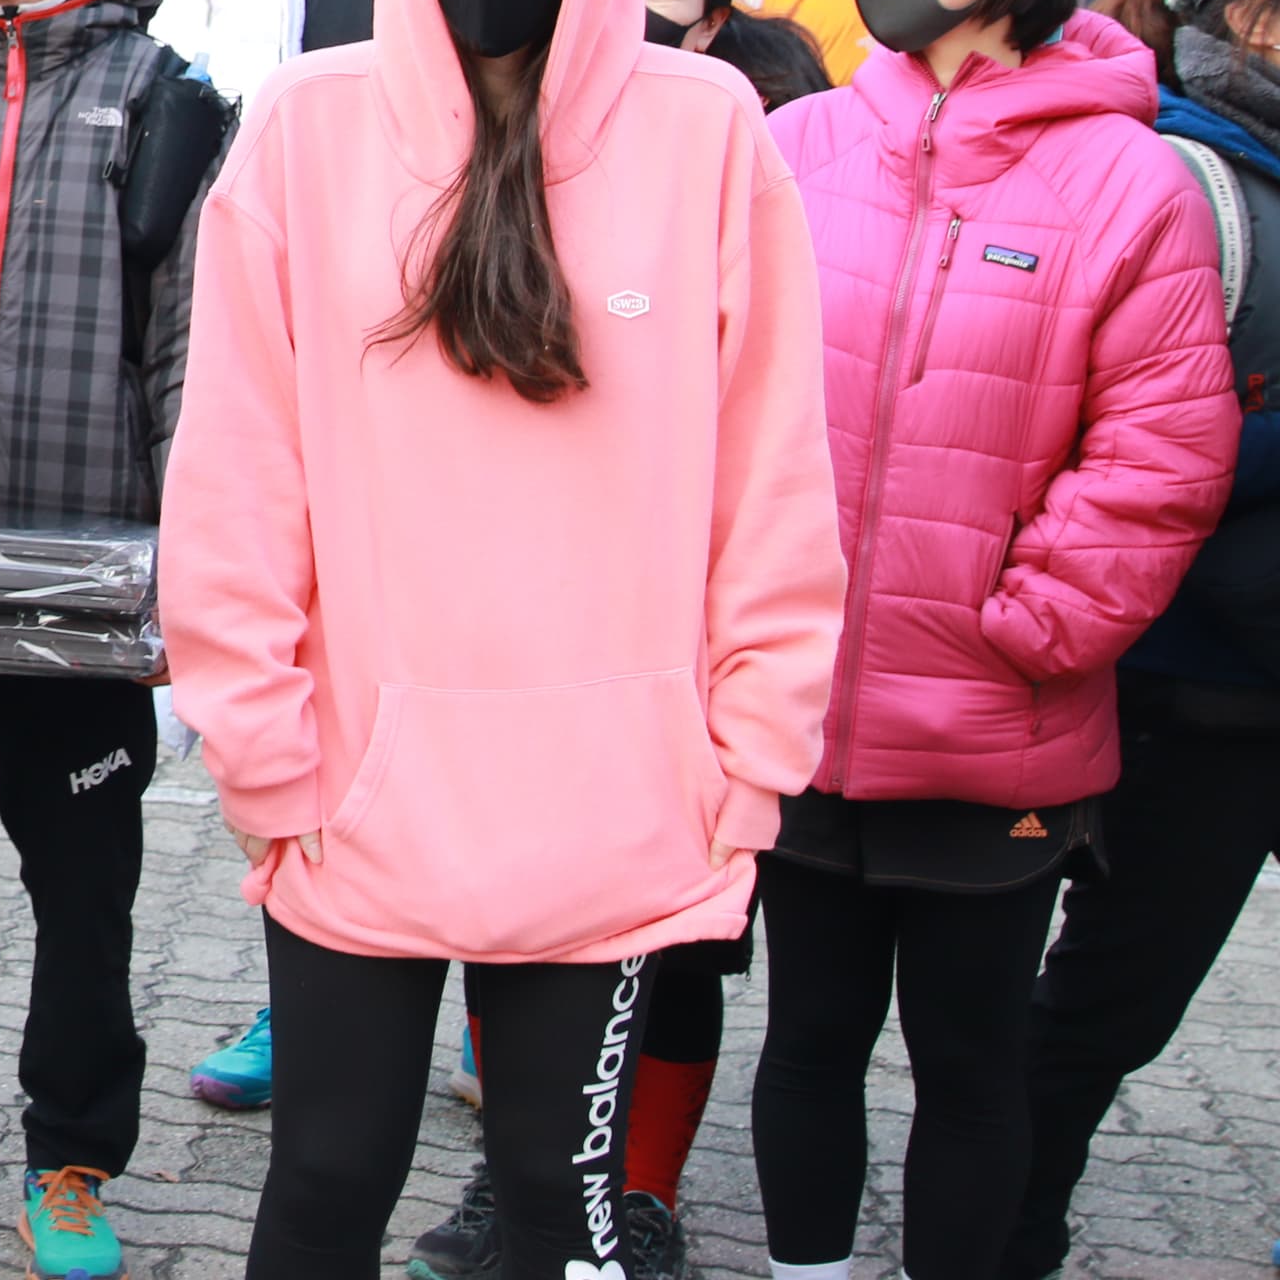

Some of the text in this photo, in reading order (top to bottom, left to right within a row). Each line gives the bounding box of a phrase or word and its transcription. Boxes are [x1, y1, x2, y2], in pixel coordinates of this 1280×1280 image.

[985, 254, 1029, 269] patagonia
[69, 747, 132, 795] HOKA
[1009, 828, 1048, 838] adidas
[583, 1173, 618, 1259] new
